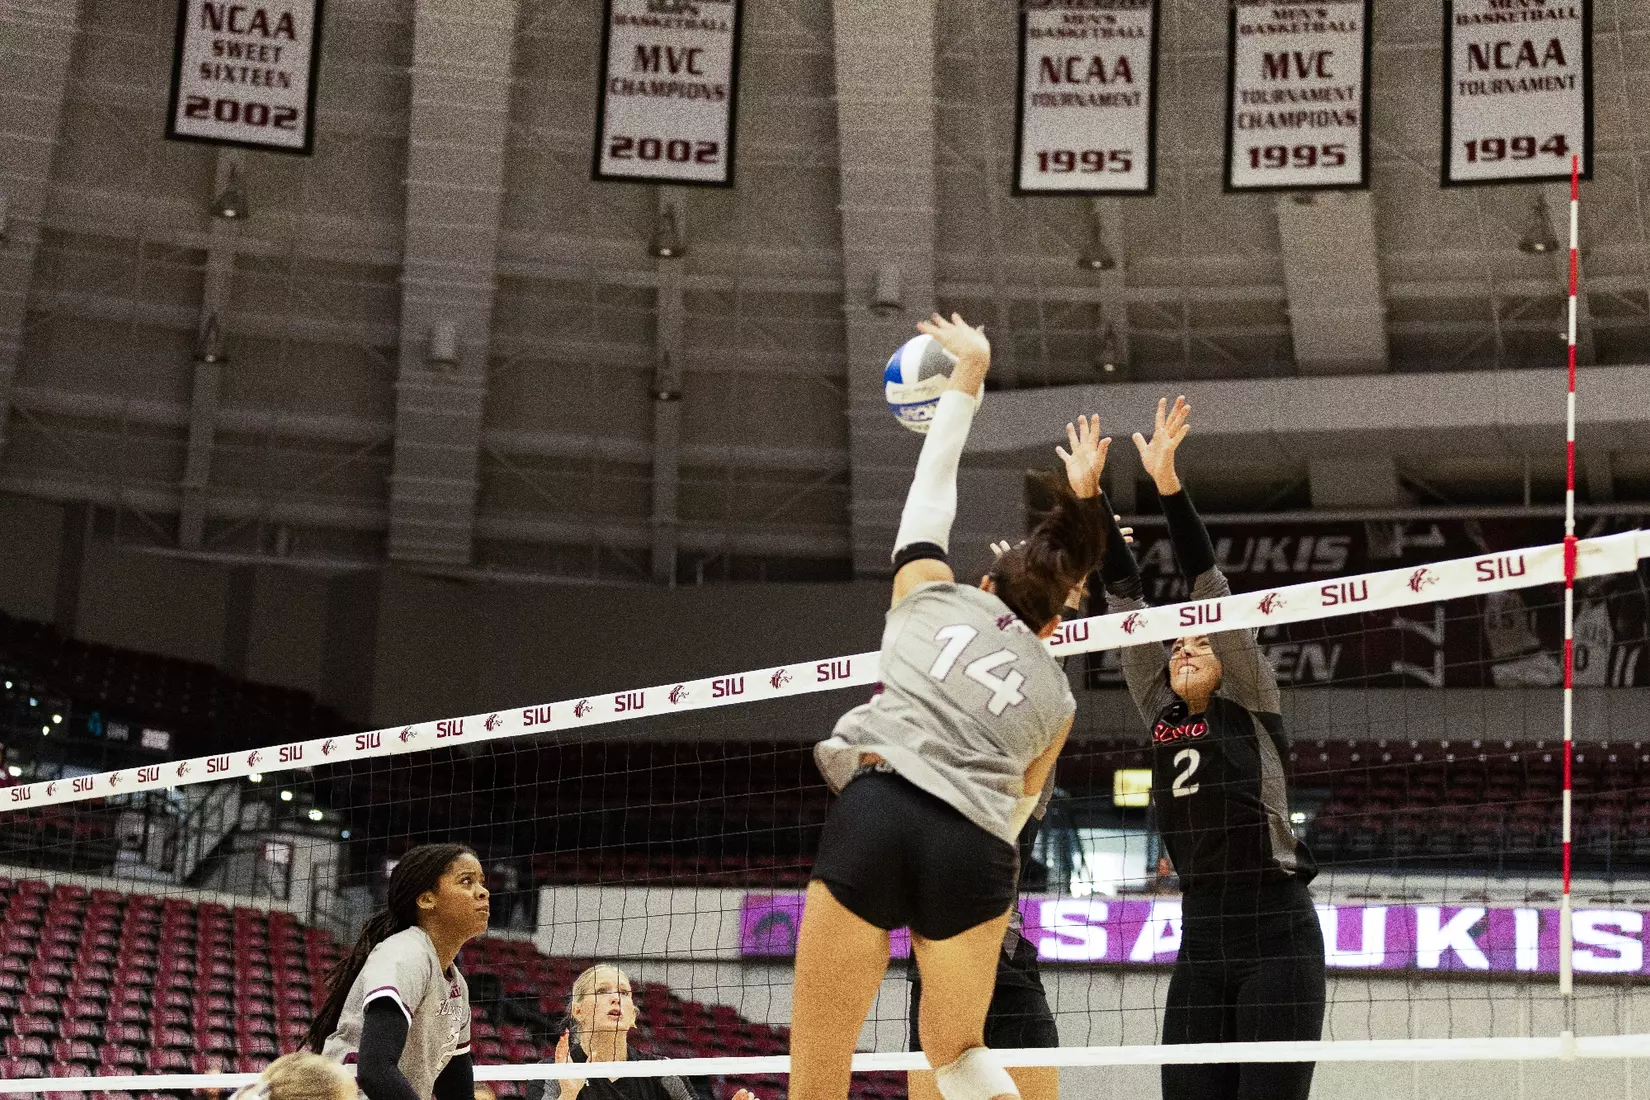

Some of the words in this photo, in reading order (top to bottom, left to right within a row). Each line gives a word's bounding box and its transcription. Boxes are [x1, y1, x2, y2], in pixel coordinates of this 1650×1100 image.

[202, 2, 296, 40] NCAA
[1240, 20, 1357, 36] BASKETBALL
[1456, 7, 1580, 26] BASKETBALL
[1030, 26, 1146, 39] BASKETBALL
[213, 39, 283, 63] SWEET
[634, 45, 704, 75] MVC
[1262, 51, 1334, 80] MVC
[1467, 37, 1567, 72] NCAA
[201, 61, 292, 89] SIXTEEN
[1040, 55, 1133, 84] NCAA
[609, 77, 726, 101] CHAMPIONS
[1032, 91, 1142, 107] TOURNAMENT
[1241, 86, 1355, 104] TOURNAMENT
[1459, 74, 1577, 96] TOURNAMENT
[185, 95, 298, 130] 2002
[1238, 109, 1357, 129] CHAMPIONS
[610, 135, 720, 164] 2002
[1037, 150, 1132, 173] 1995
[1249, 144, 1346, 169] 1995
[1464, 134, 1569, 163] 1994
[1133, 536, 1351, 574] AUKIS
[11, 787, 31, 802] SIU
[73, 777, 94, 793] SIU
[138, 766, 160, 784] SIU
[206, 755, 230, 774] SIU
[279, 744, 303, 763] SIU
[355, 731, 381, 751] SIU
[436, 719, 464, 739] SIU
[523, 706, 551, 727] SIU
[614, 691, 645, 713] SIU
[712, 676, 744, 699] SIU
[816, 659, 851, 683] SIU
[1050, 621, 1089, 646] SIU
[1179, 602, 1222, 627] SIU
[1320, 579, 1369, 607] SIU
[1475, 554, 1526, 583] SIU
[929, 623, 1026, 717] 14
[1172, 748, 1200, 798] 2
[1039, 900, 1643, 972] SAUKIS
